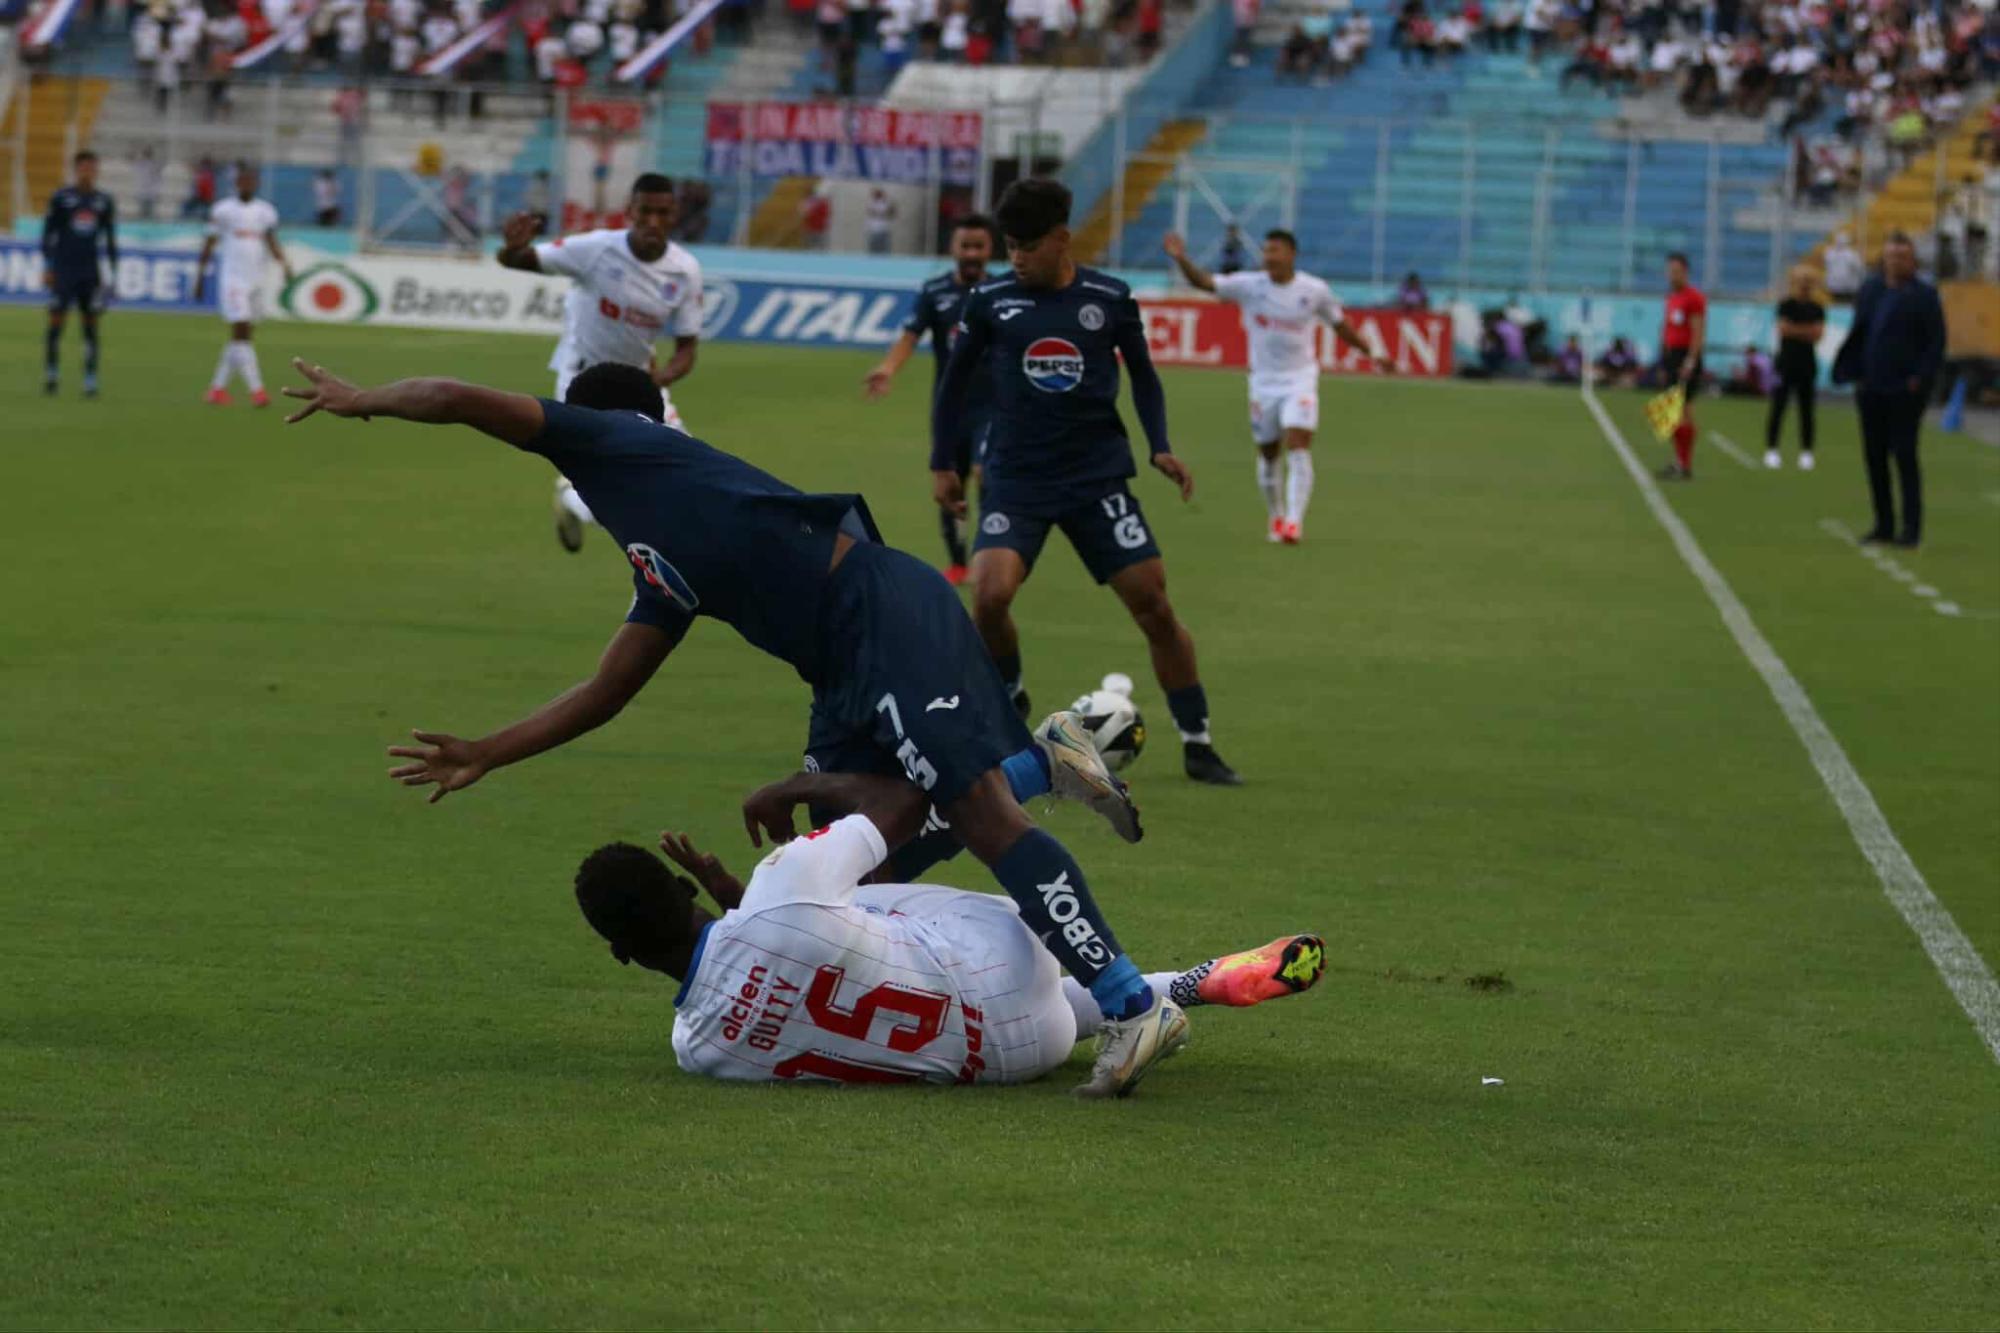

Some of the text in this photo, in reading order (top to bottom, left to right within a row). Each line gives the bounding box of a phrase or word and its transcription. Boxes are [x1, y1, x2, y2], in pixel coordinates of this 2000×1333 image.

[1028, 359, 1082, 372] PEPSI
[1101, 492, 1128, 519] 17
[1036, 870, 1116, 970] GBOX
[720, 965, 768, 1041] alcien
[747, 976, 800, 1052] GUITY
